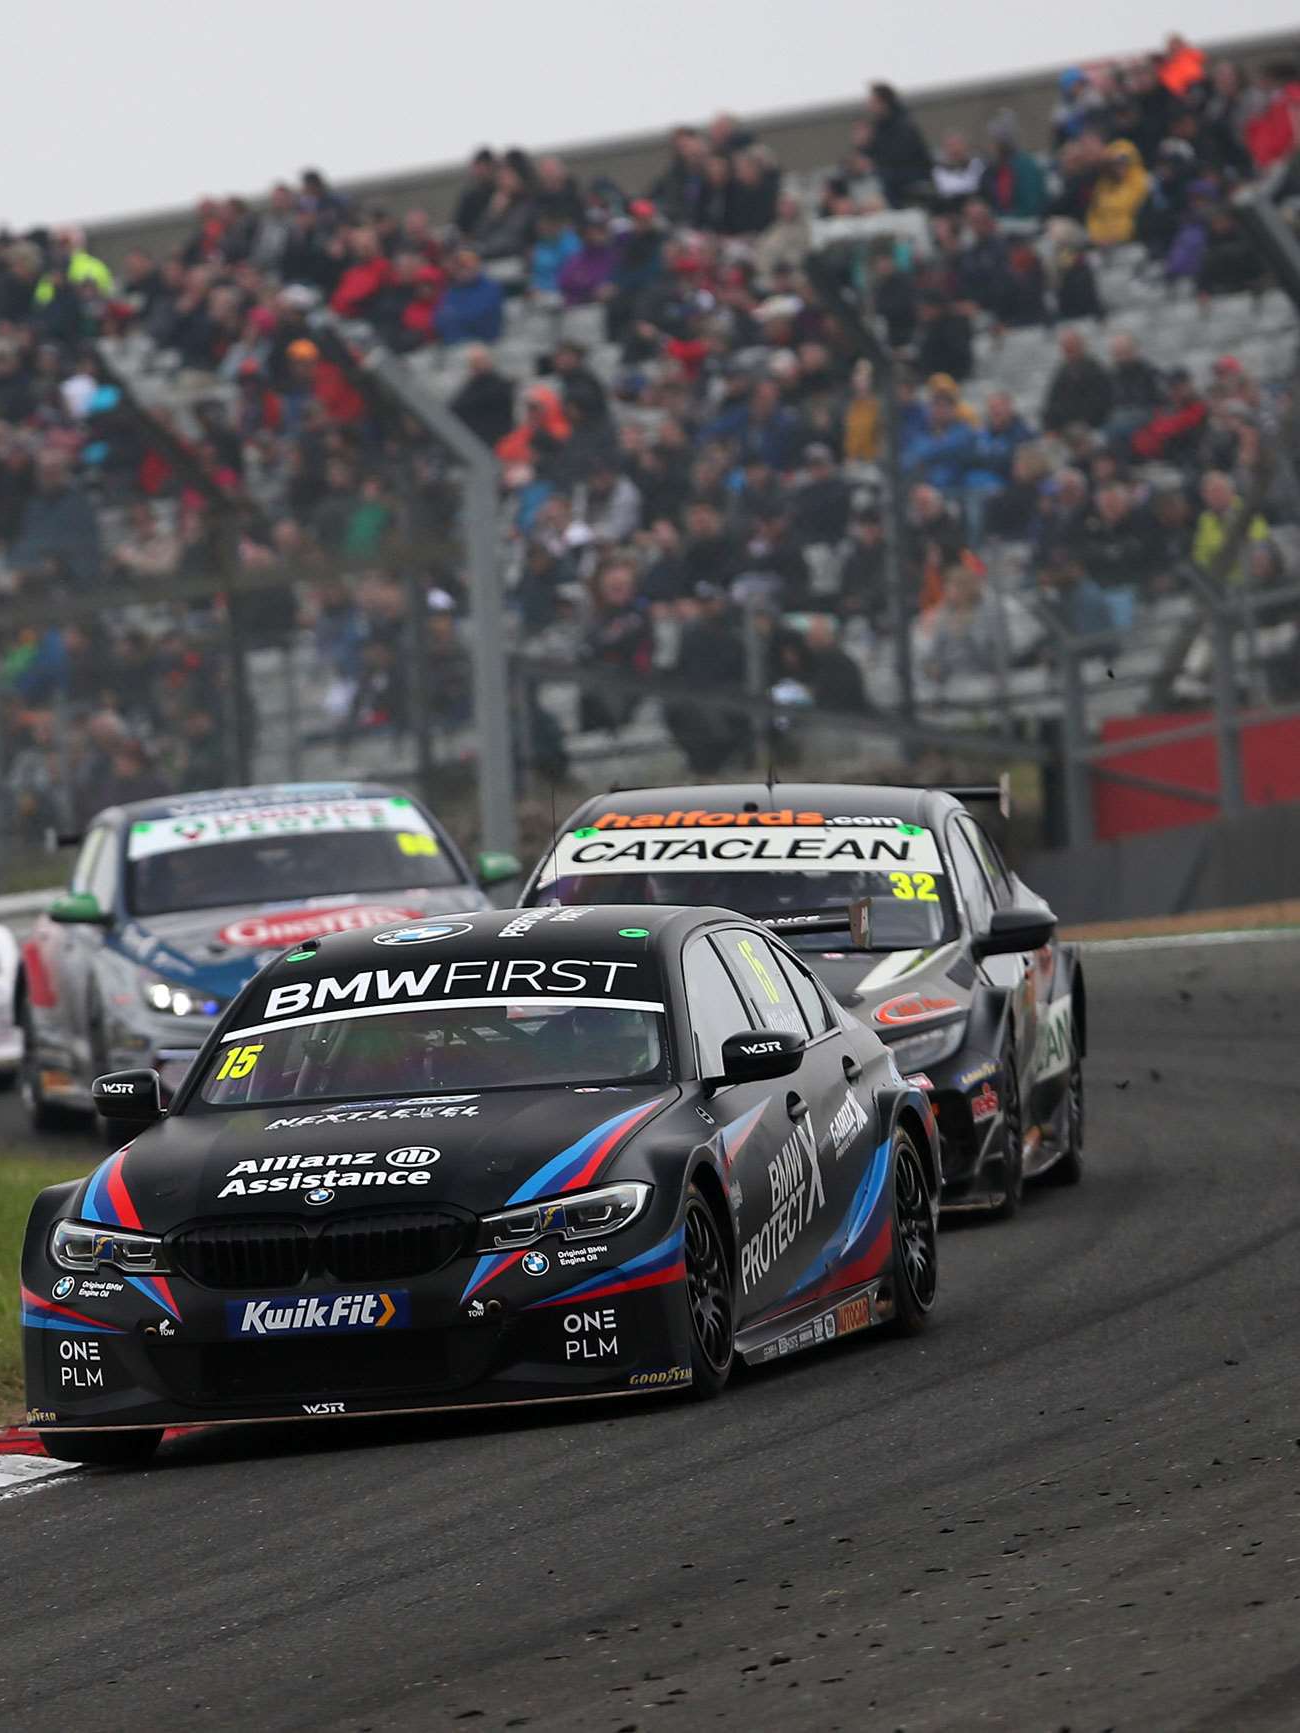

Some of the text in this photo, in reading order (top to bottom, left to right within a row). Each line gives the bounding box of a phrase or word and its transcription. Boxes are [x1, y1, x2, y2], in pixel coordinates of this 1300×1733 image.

[593, 809, 903, 828] halfords.com
[571, 839, 910, 863] CATACLEAN
[889, 872, 939, 901] 32
[740, 1041, 782, 1055] WSR
[215, 1044, 265, 1081] 15
[102, 1083, 135, 1094] WSR
[226, 1152, 377, 1177] Allianz
[767, 1131, 803, 1213] BMW
[217, 1169, 431, 1199] Assistance
[741, 1180, 806, 1295] PROTECT
[557, 1245, 608, 1259] Original BMW
[560, 1254, 598, 1266] Engine Oil
[468, 1308, 485, 1318] TOW
[563, 1309, 617, 1334] ONE
[160, 1328, 175, 1337] TOW
[59, 1340, 101, 1361] ONE
[566, 1335, 618, 1360] PLM
[61, 1367, 104, 1388] PLM
[302, 1402, 348, 1415] WSR
